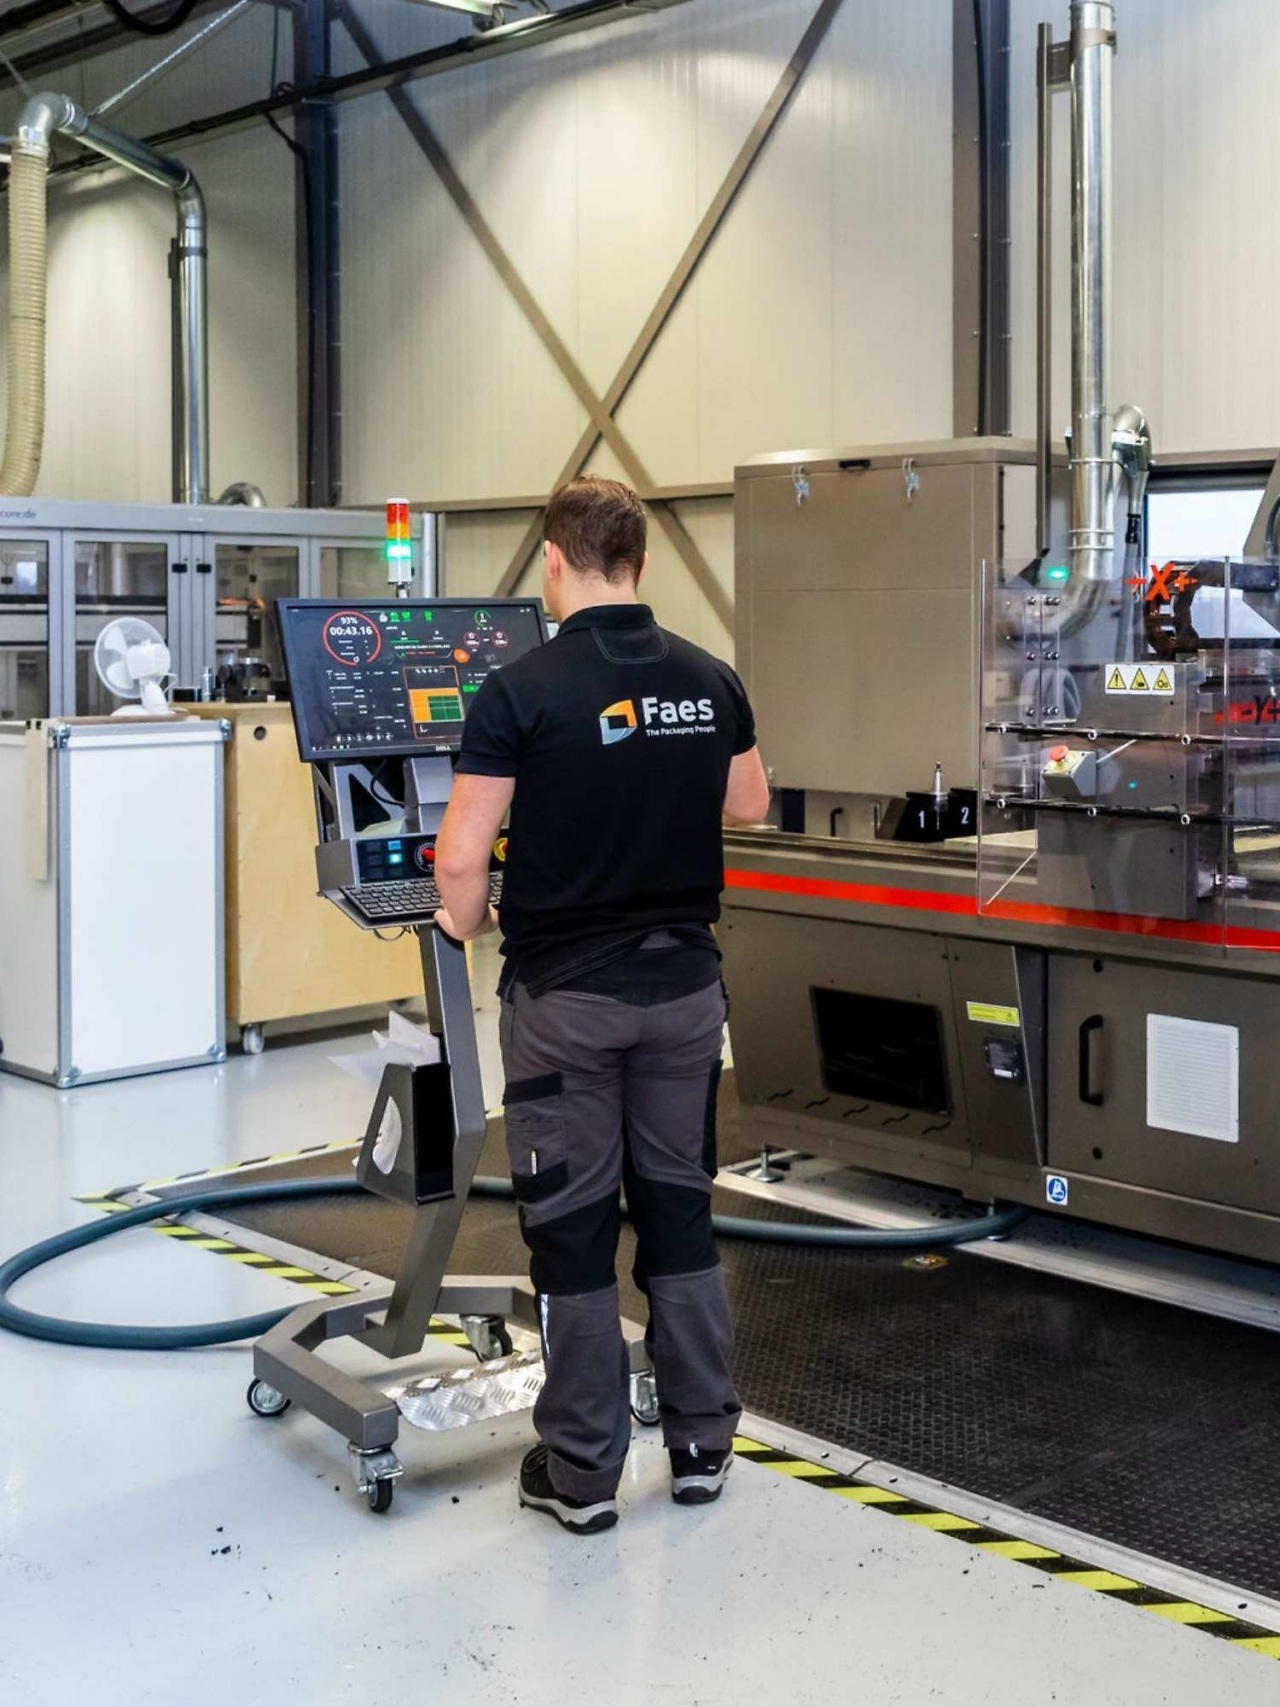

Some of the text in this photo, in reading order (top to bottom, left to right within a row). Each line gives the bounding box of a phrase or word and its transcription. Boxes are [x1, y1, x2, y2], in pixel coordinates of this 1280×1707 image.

[330, 626, 373, 636] 00:43.16
[641, 696, 715, 725] Faes
[646, 725, 716, 737] The Packaging People
[918, 806, 969, 828] 1 2
